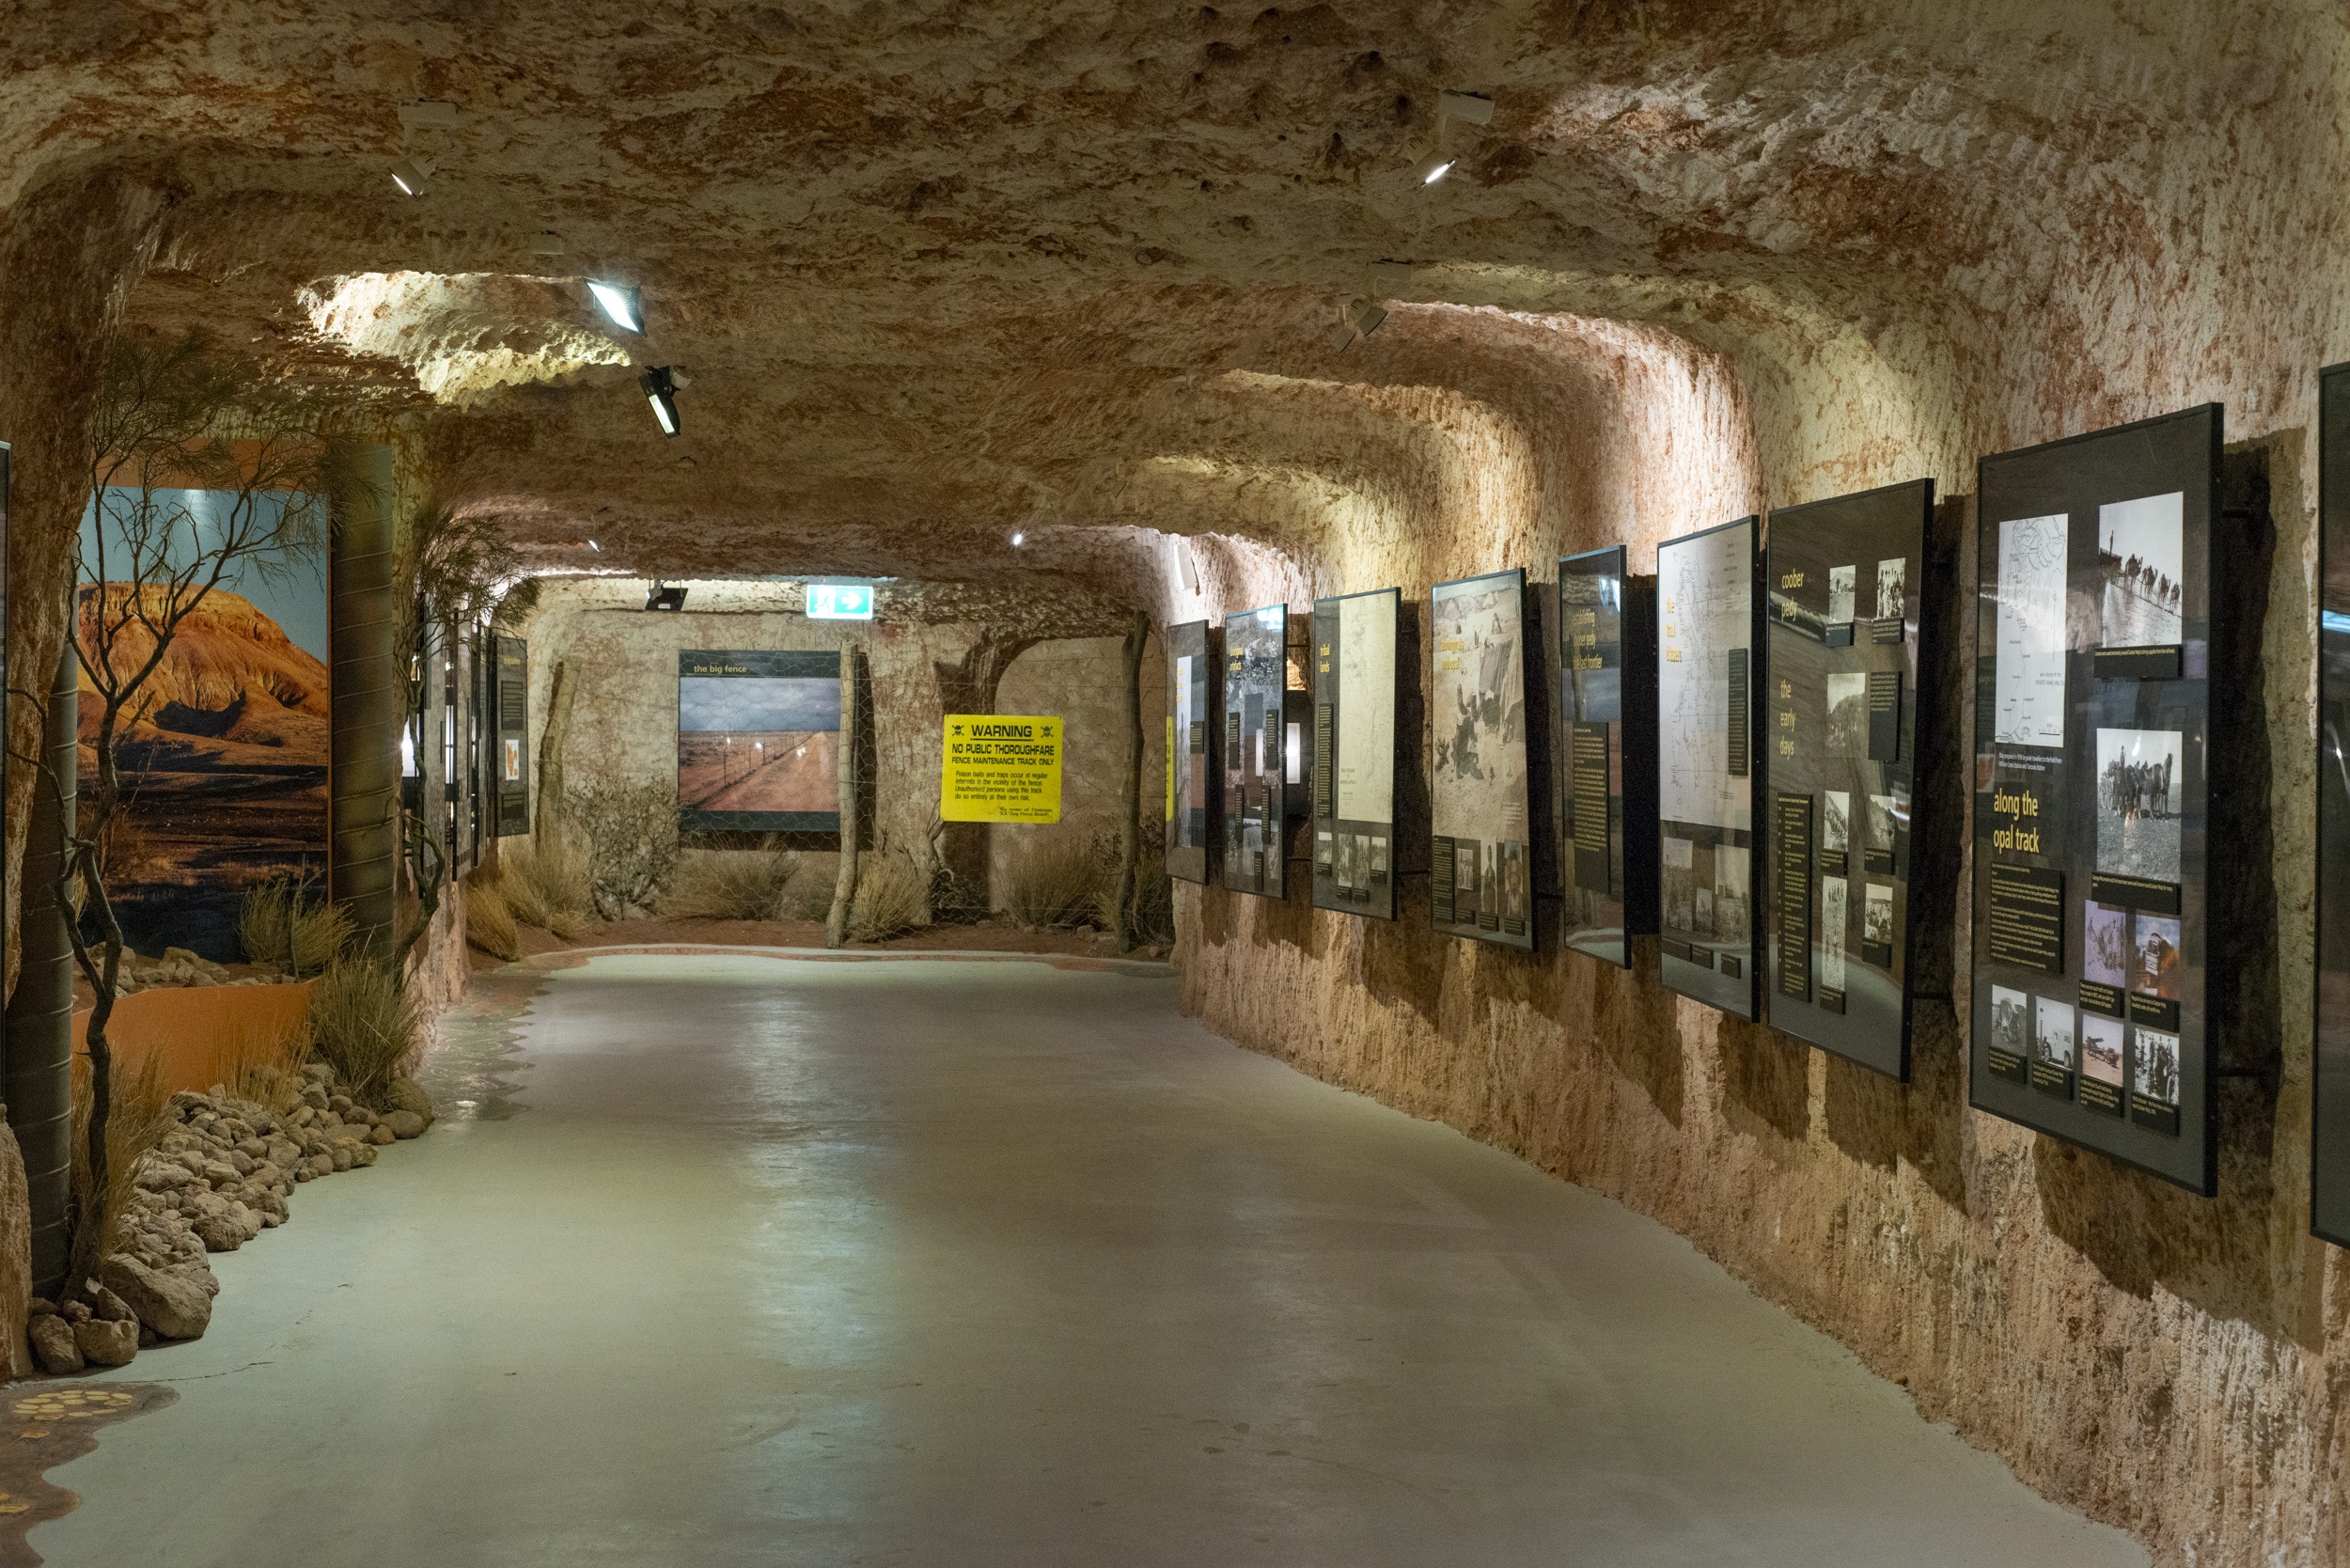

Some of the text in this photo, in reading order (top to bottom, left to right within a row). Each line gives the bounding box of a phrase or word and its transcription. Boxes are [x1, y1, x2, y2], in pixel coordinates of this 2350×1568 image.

[1781, 568, 1804, 589] coober
[1781, 597, 1797, 622] pedy
[1586, 630, 1596, 650] pedy
[1320, 644, 1330, 656] tribal
[709, 666, 723, 674] big
[725, 665, 747, 673] fence
[1320, 661, 1330, 673] lands
[1780, 679, 1791, 698] the
[1780, 707, 1795, 732] early
[971, 725, 1032, 737] WARNING
[952, 744, 1055, 756] NO PUBLIC THOROUGHFARE
[1779, 735, 1794, 760] days
[973, 757, 1015, 765] MAINTENANCE
[1031, 772, 1048, 780] regular
[1006, 787, 1019, 795] using
[1994, 788, 2038, 821] along the
[1993, 823, 2039, 855] opal track
